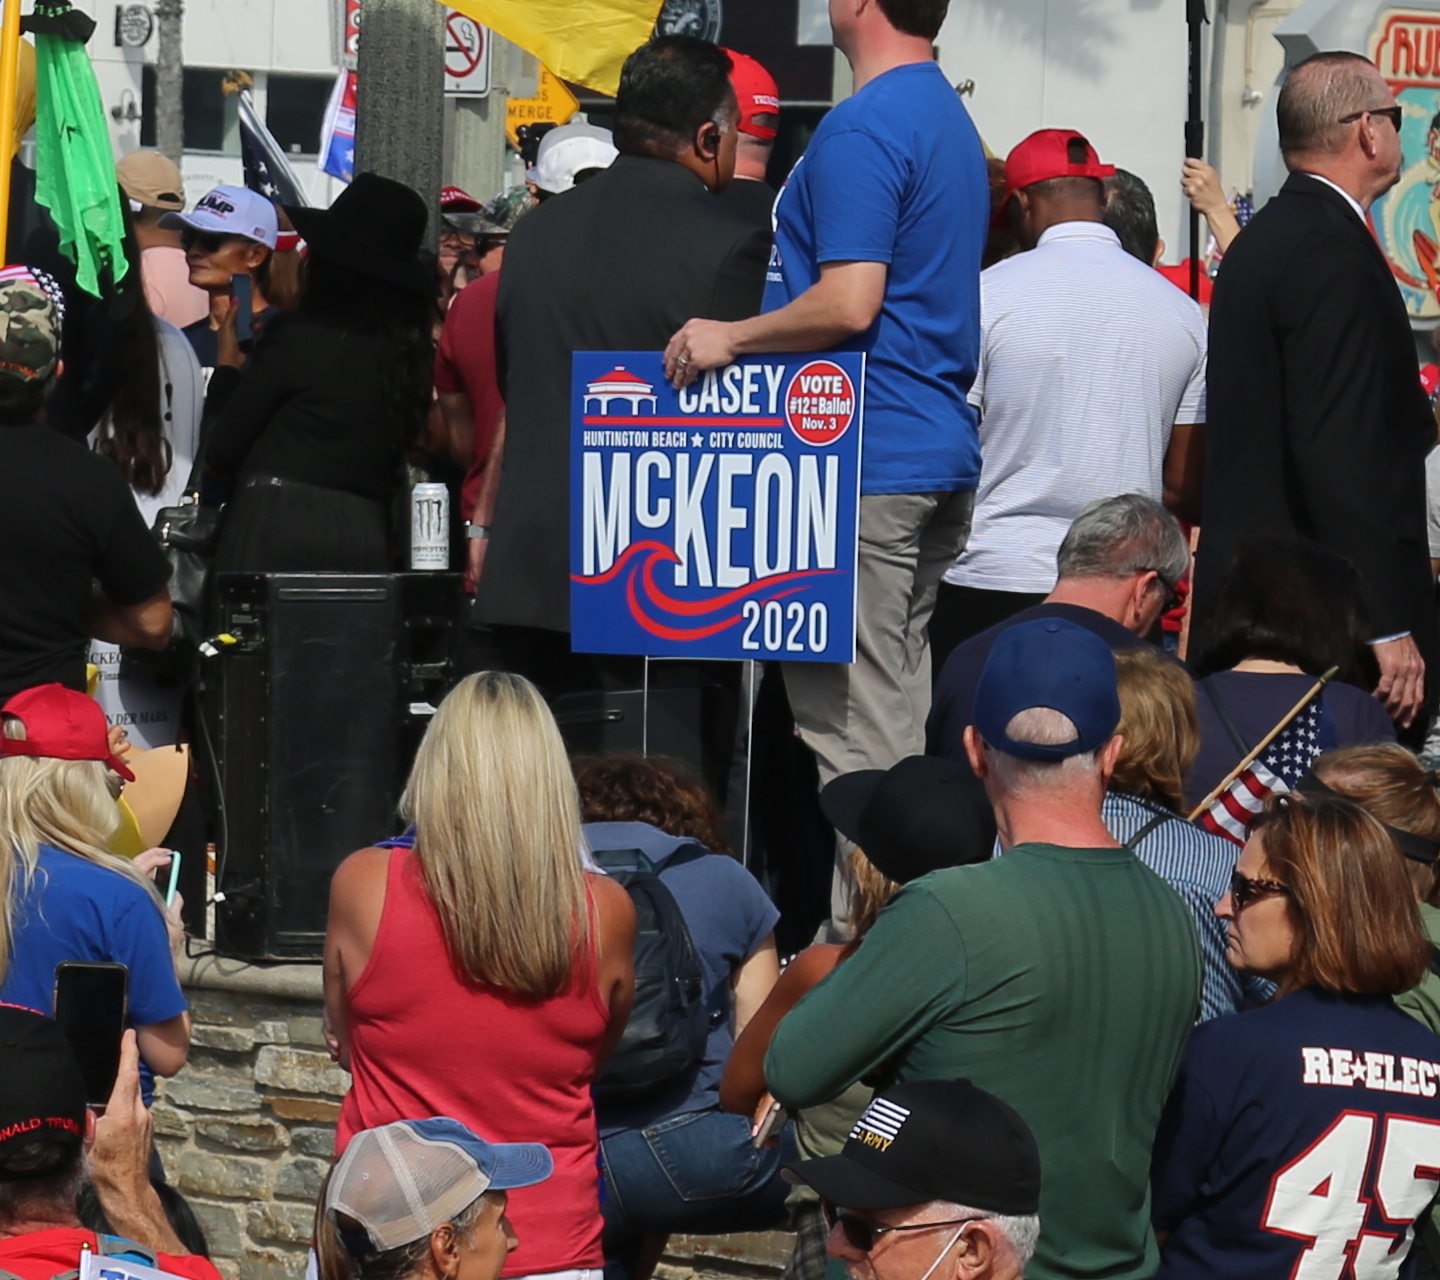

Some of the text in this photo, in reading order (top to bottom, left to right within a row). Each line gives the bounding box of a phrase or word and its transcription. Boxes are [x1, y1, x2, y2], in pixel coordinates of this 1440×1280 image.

[508, 106, 554, 119] MERGE
[678, 364, 786, 415] CASEY
[800, 375, 843, 394] VOTE
[789, 396, 811, 415] #12
[818, 396, 852, 415] Ballot
[801, 416, 837, 430] Nov. 3
[583, 430, 785, 449] HUNTINGTON BEACH CITY COUNCIL
[740, 599, 828, 653] 2020
[45, 1116, 81, 1136] TRUM
[858, 1130, 892, 1153] ARMY
